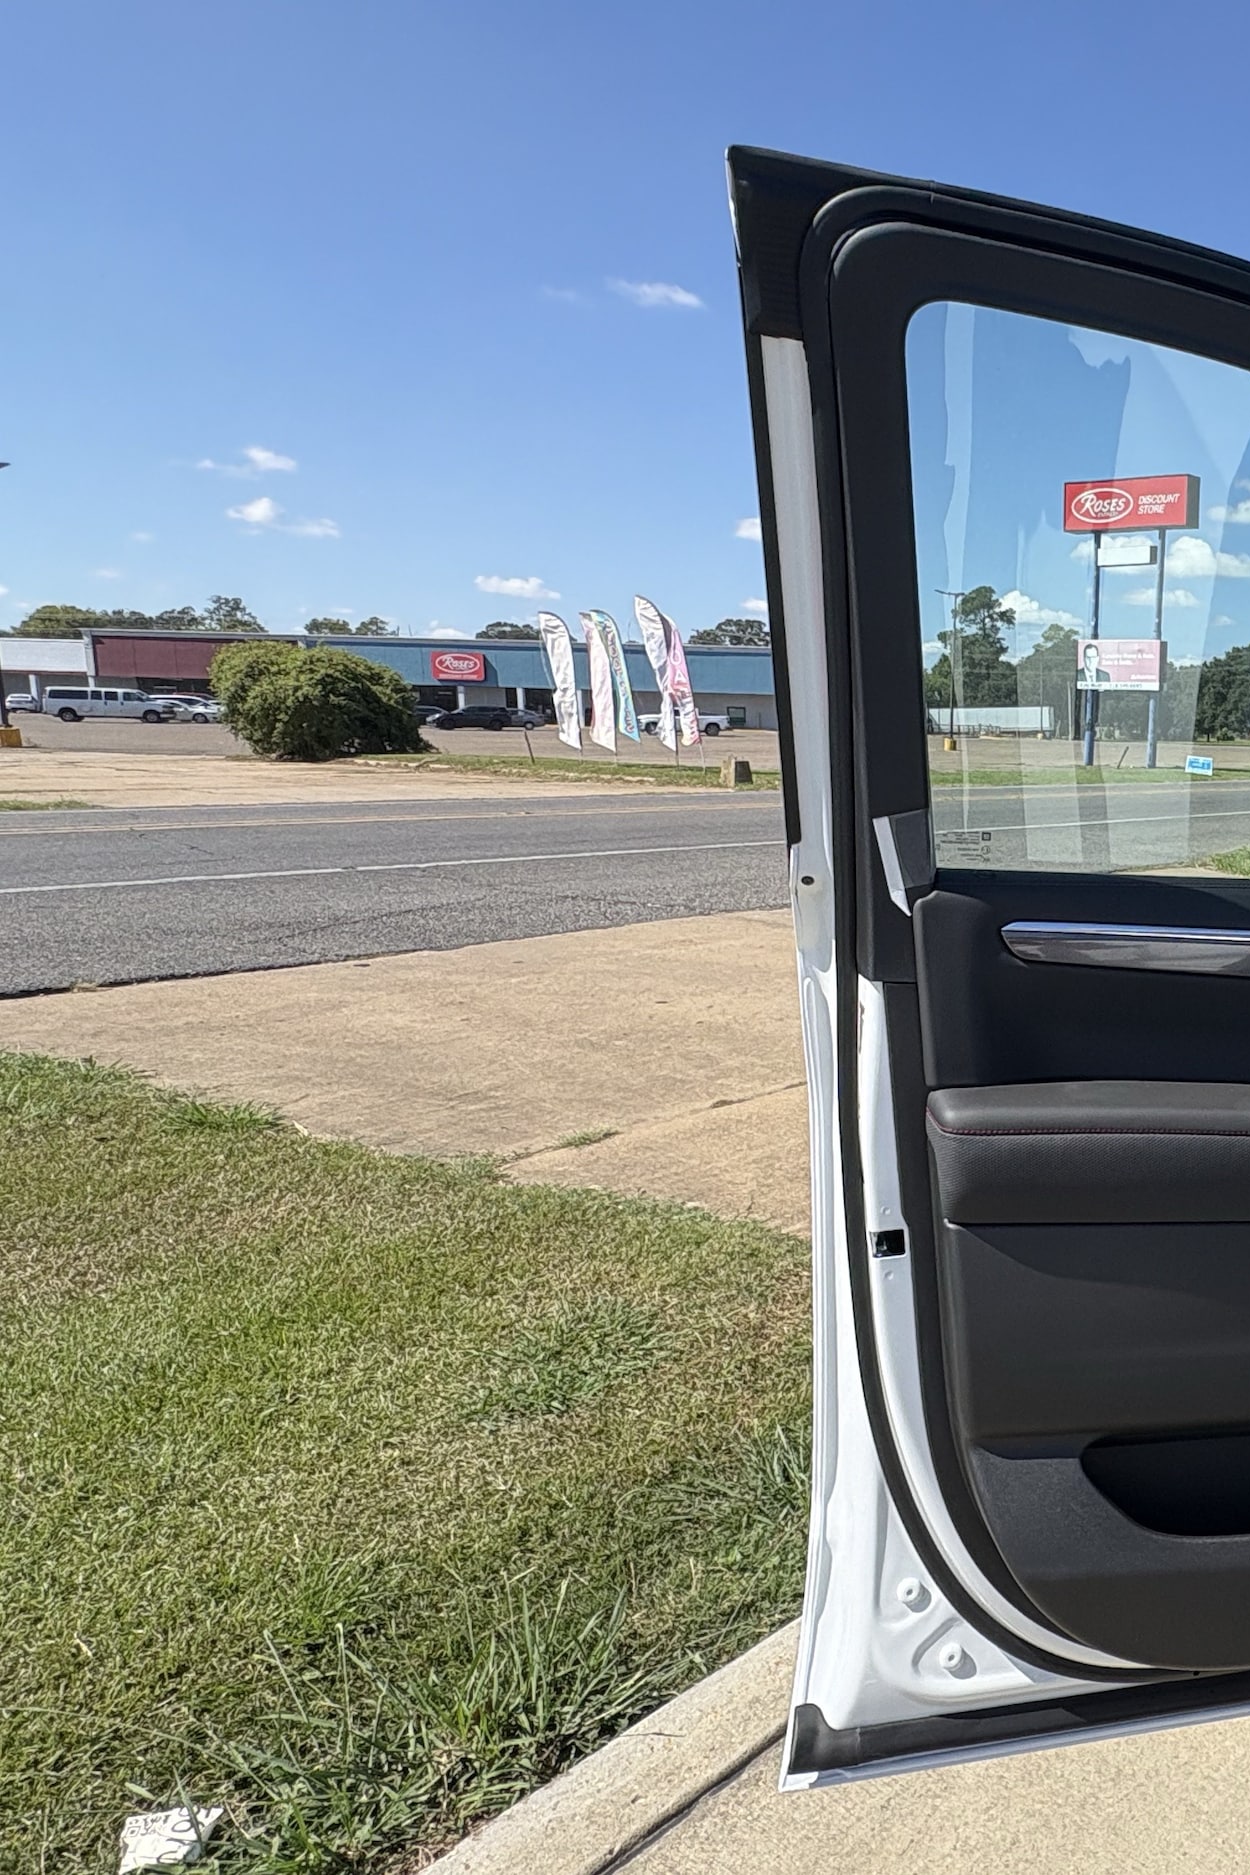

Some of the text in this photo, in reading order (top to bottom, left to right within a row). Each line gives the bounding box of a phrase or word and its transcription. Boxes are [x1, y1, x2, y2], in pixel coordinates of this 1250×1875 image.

[1138, 493, 1181, 505] DISCOUNT
[1080, 494, 1127, 517] ROSES
[1137, 504, 1165, 515] STORE
